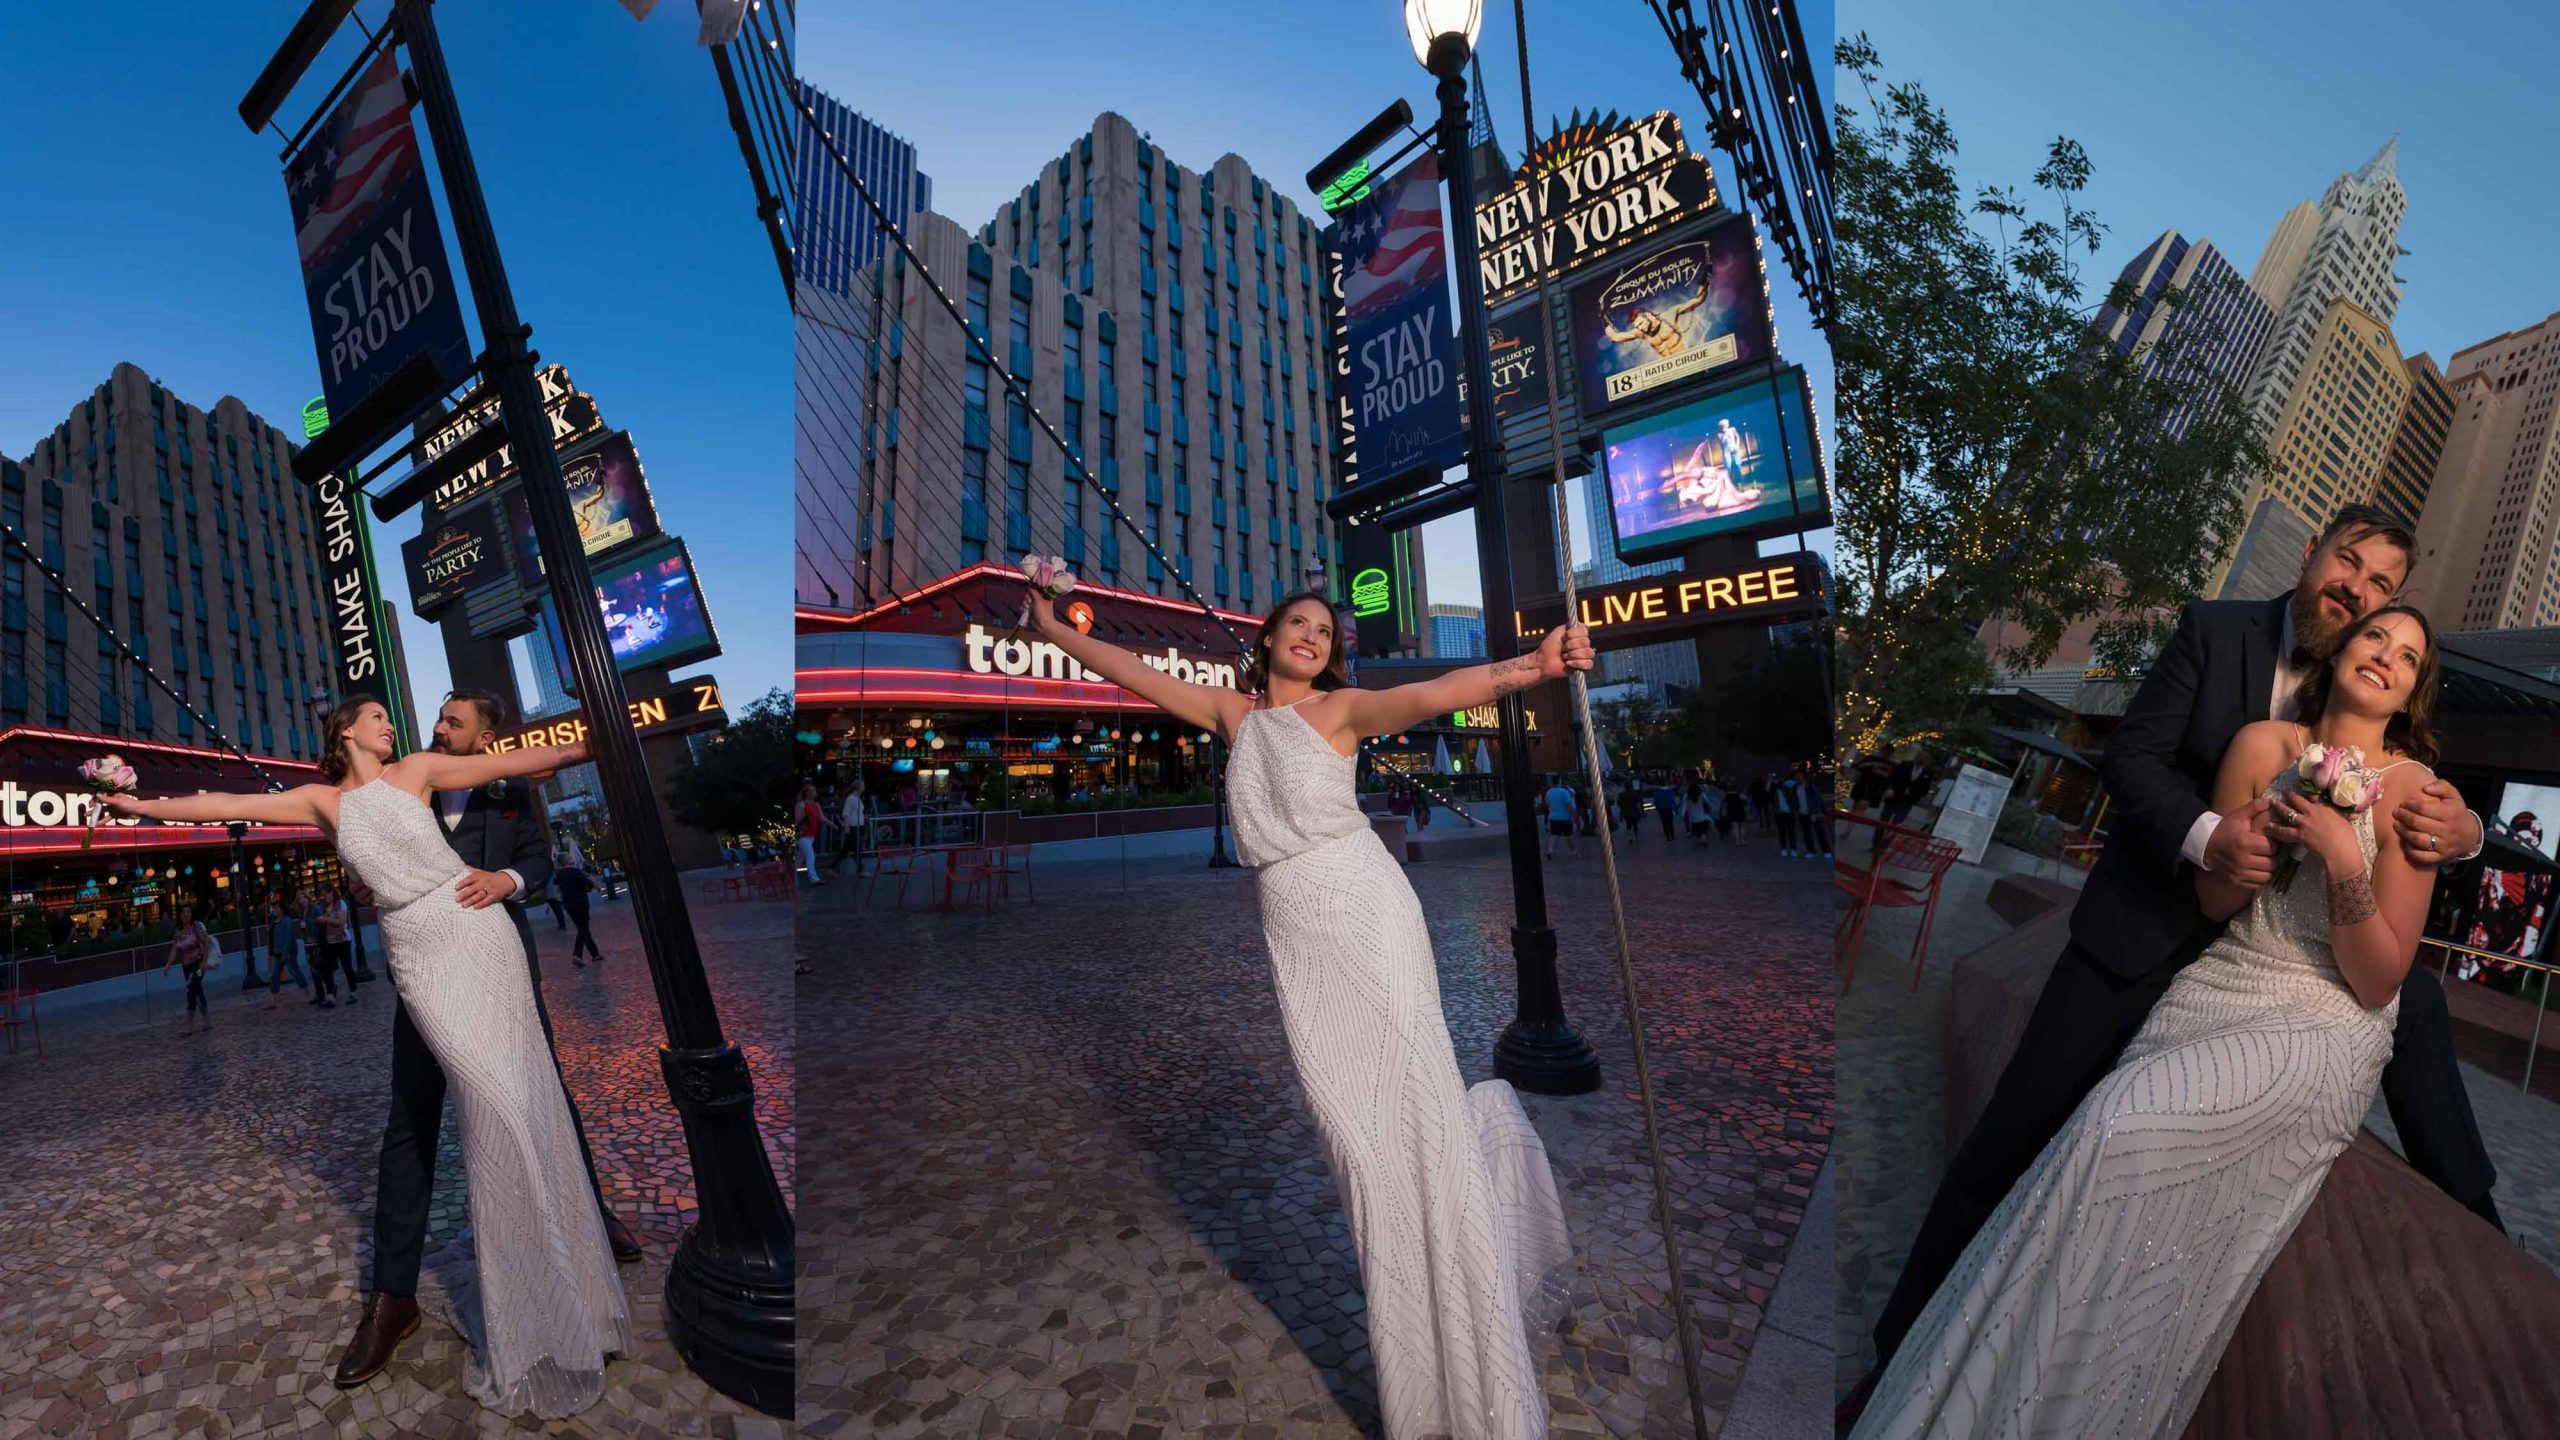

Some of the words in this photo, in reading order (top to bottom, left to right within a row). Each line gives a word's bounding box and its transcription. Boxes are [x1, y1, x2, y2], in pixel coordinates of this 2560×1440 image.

[1476, 177, 1550, 248] NEW
[1559, 117, 1672, 203] YORK
[1480, 226, 1556, 296] NEW
[1565, 169, 1680, 254] YORK
[324, 207, 414, 341] STAY
[1610, 262, 1702, 309] ZUMANITY
[1615, 275, 1646, 292] CIRQUE
[1648, 268, 1661, 280] DU
[1662, 257, 1693, 273] SOLEIL
[330, 265, 435, 385] PROUD
[1361, 304, 1436, 391] STAY
[1506, 350, 1522, 362] LIKE
[1523, 345, 1536, 355] TO
[1645, 361, 1673, 378] RATED
[1675, 349, 1709, 368] CIRQUE
[1362, 358, 1445, 428] PROUD
[435, 457, 487, 503] NEW
[568, 465, 590, 478] SOLEIL
[426, 546, 484, 583] PARTY.
[473, 536, 482, 546] TO
[334, 567, 376, 681] SHAKE
[1581, 588, 1667, 628] LIVE
[1678, 566, 1799, 613] FREE
